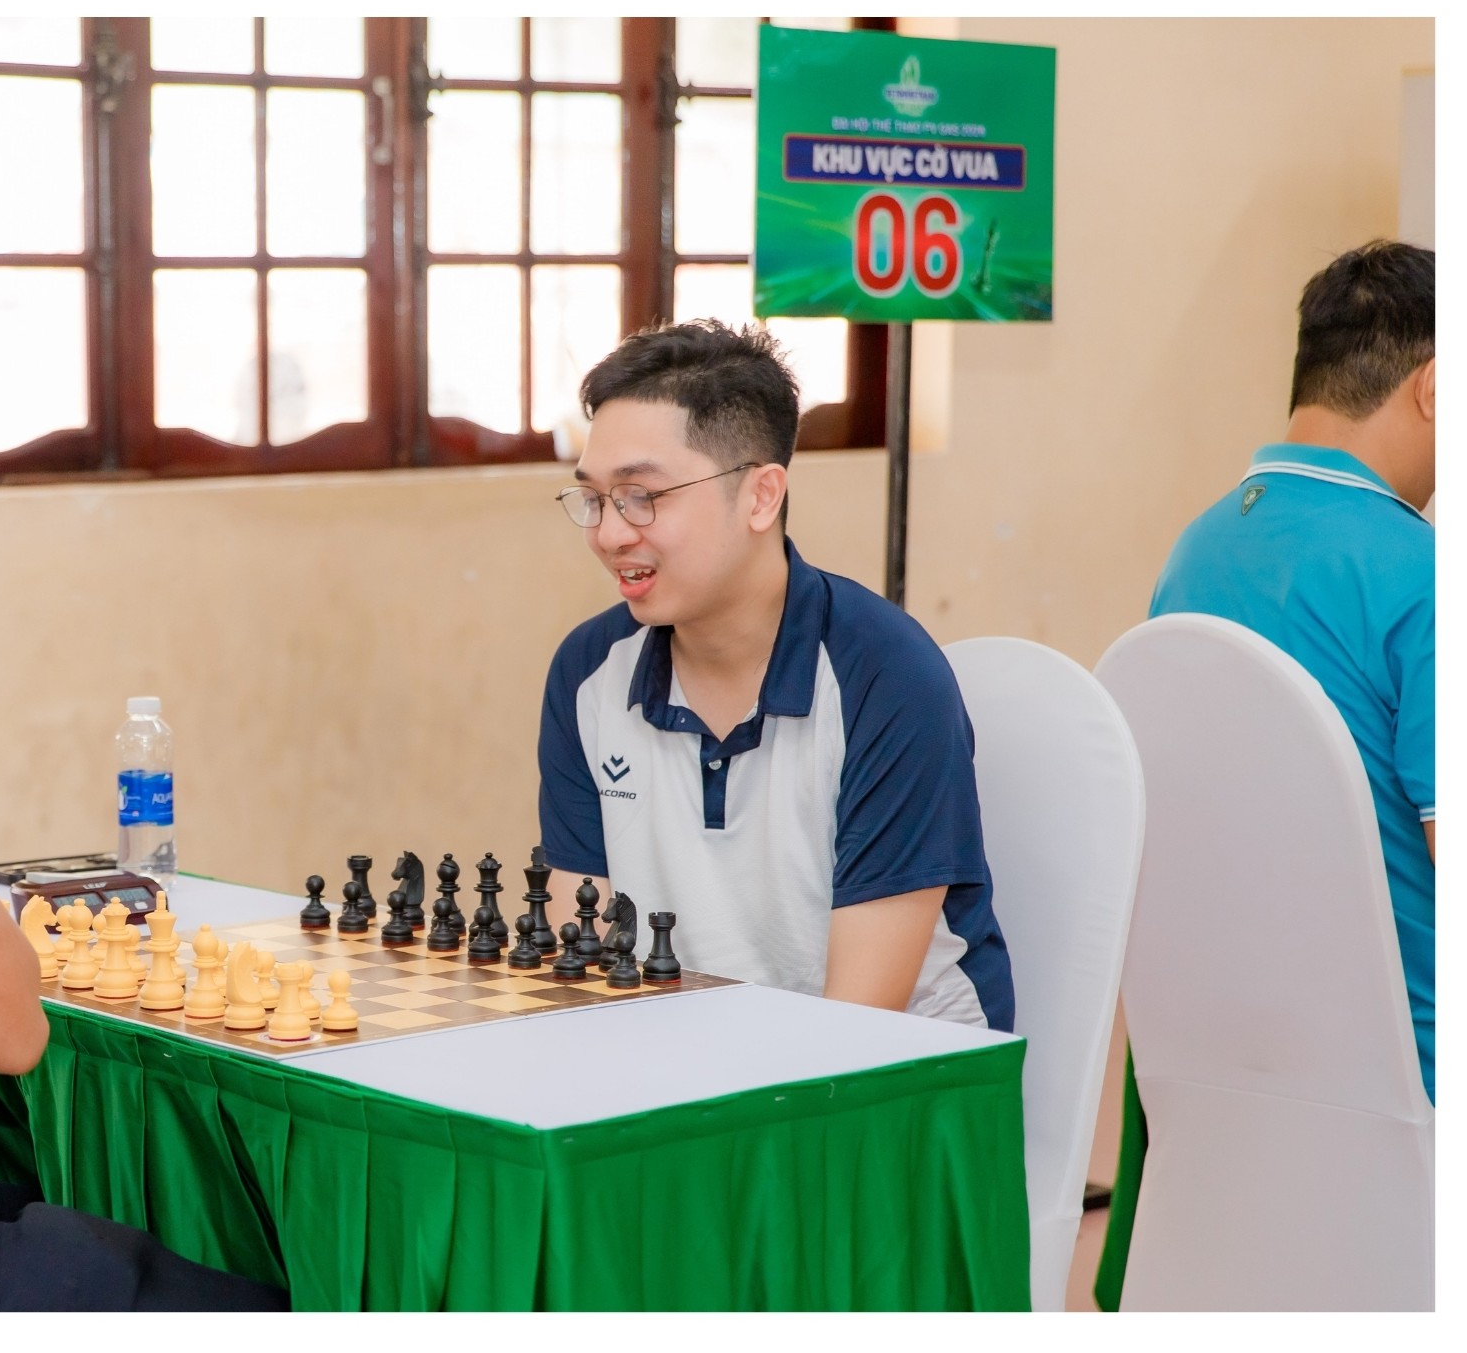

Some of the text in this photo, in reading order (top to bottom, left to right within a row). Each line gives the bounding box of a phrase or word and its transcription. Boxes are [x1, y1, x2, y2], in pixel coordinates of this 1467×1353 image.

[812, 144, 863, 175] KHU
[865, 145, 914, 183] VỰC
[949, 150, 999, 181] VUA
[855, 192, 961, 294] 06
